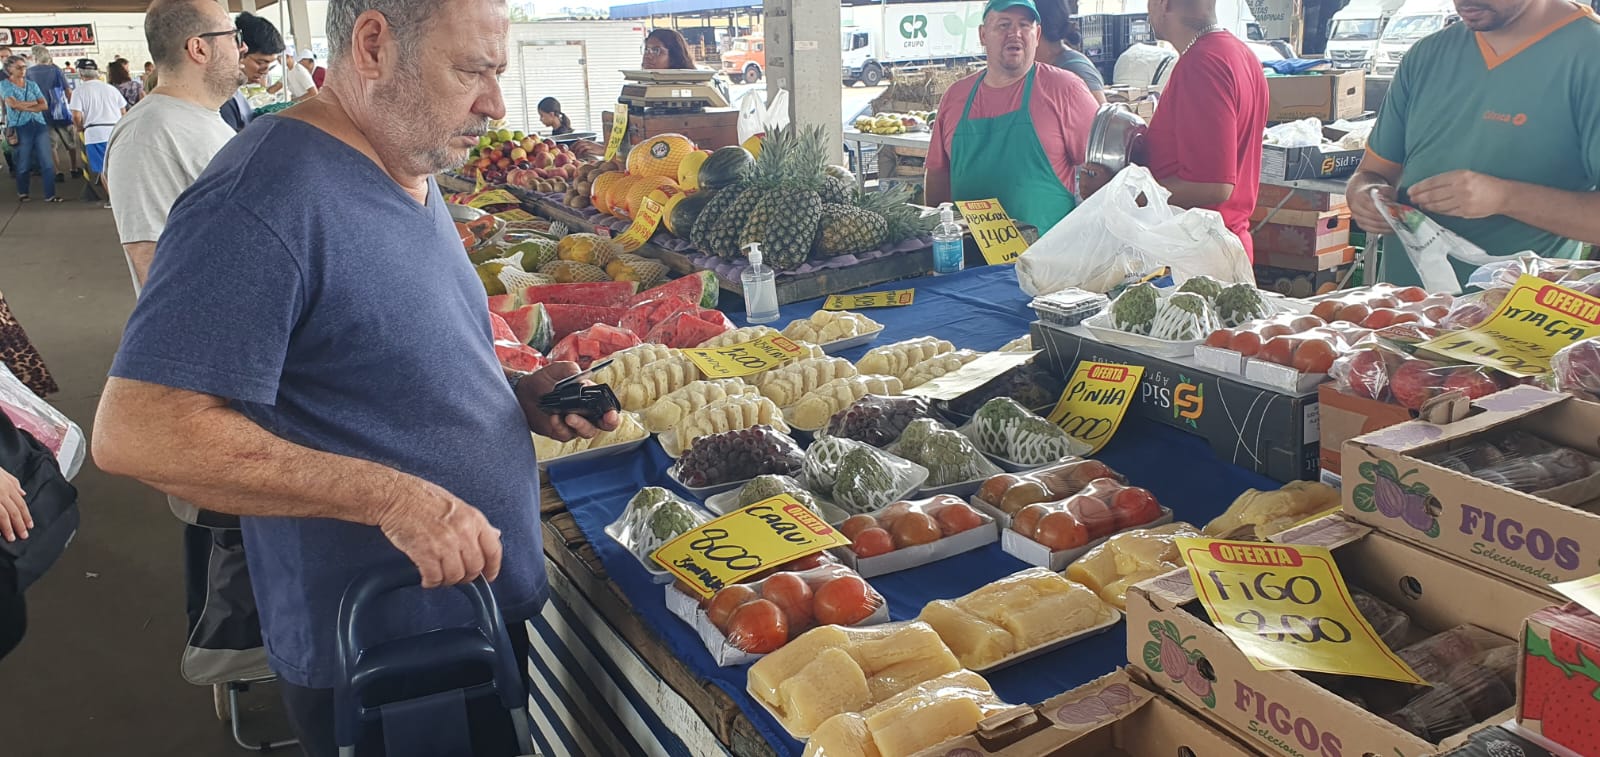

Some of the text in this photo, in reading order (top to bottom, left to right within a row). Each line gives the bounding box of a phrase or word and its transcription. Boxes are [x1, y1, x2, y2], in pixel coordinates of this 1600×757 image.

[12, 26, 95, 45] PASTEL
[899, 14, 928, 39] CR
[1335, 156, 1348, 168] Sid
[1543, 289, 1600, 321] OFERTA
[1092, 366, 1123, 382] OFERTA
[1143, 382, 1170, 408] Sid
[788, 507, 825, 534] OFERTA
[1459, 504, 1580, 570] FIGOS
[1220, 548, 1292, 565] OFERTA
[1470, 542, 1559, 583] Selecionadas
[1234, 679, 1342, 757] FIGOS
